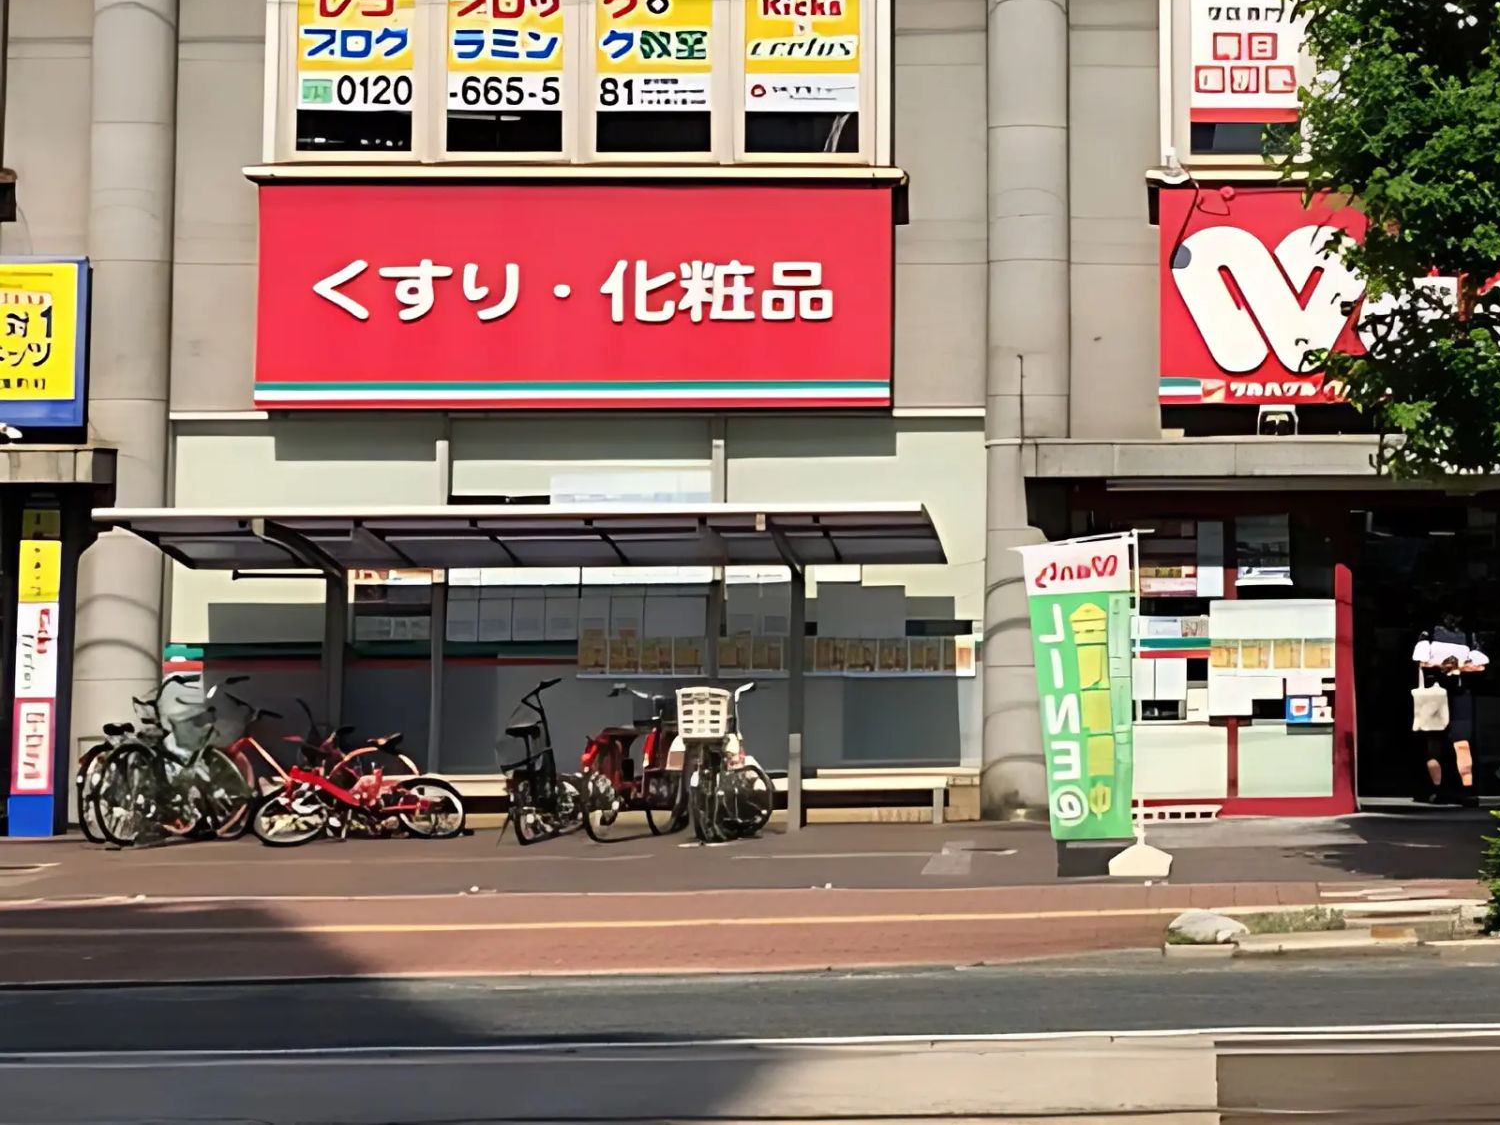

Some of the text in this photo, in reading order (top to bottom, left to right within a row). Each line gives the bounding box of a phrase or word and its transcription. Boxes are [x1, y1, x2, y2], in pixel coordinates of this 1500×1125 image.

[313, 259, 834, 323] くすり・化粧品
